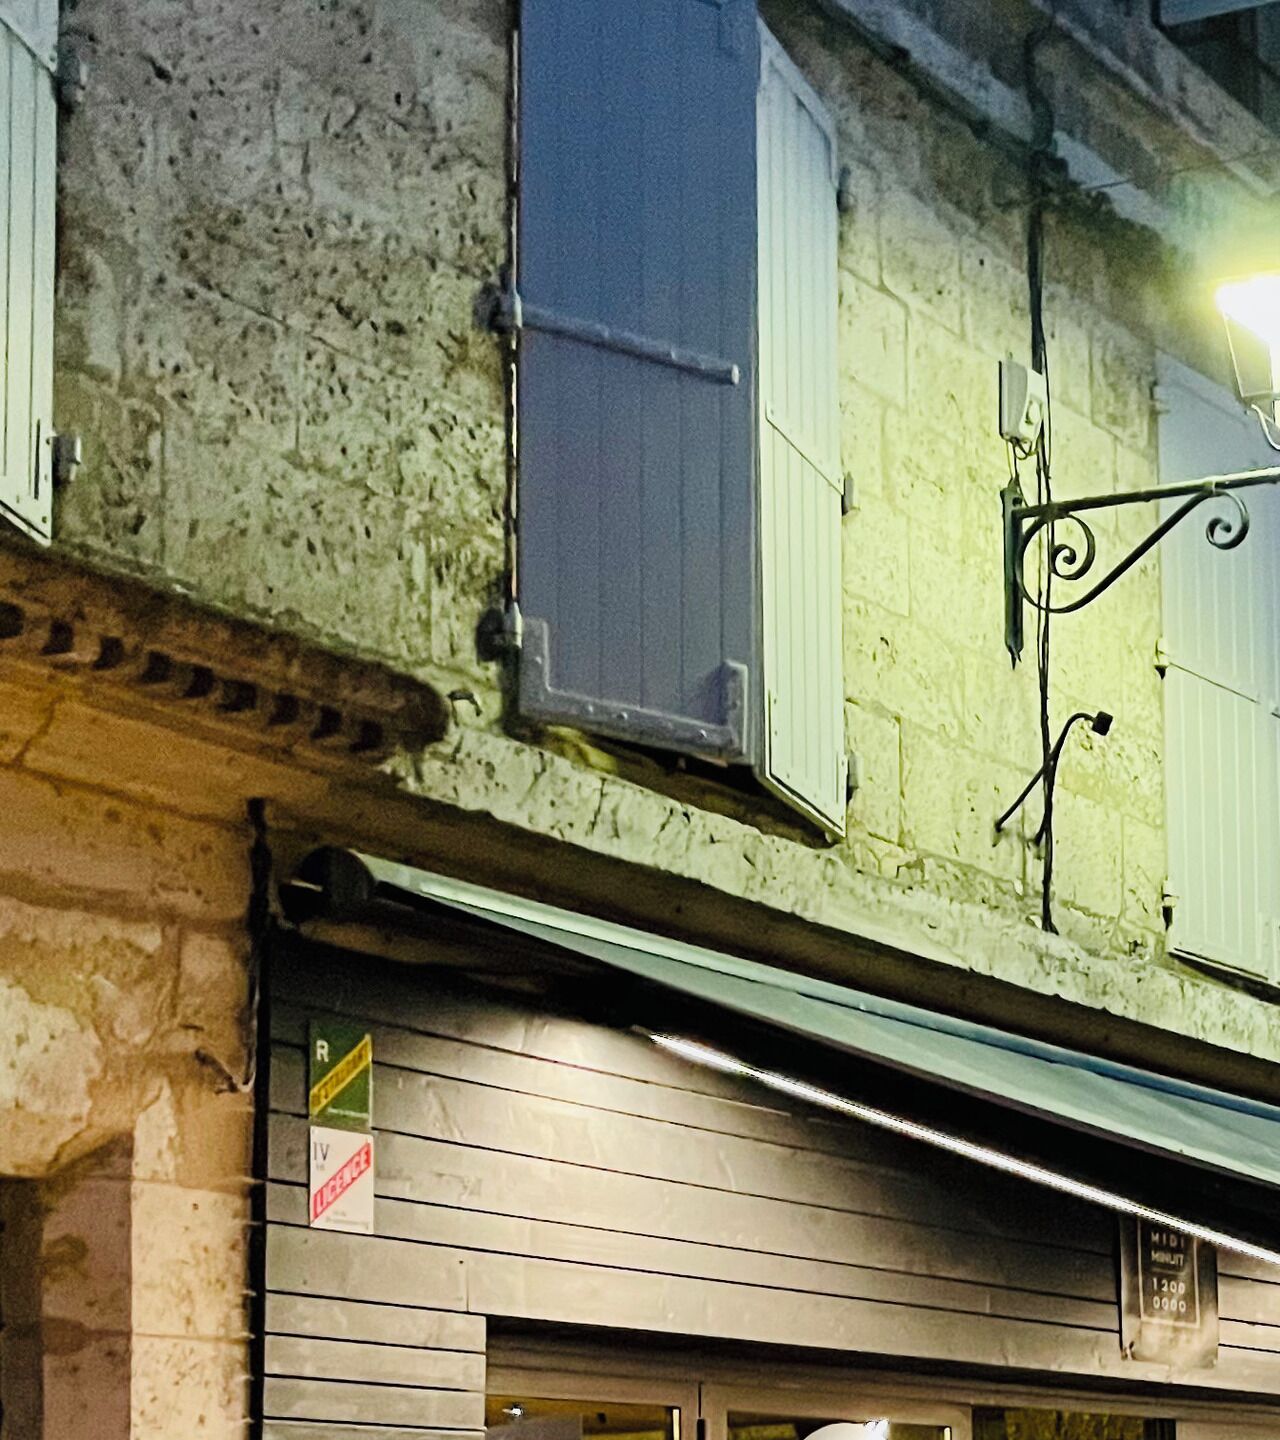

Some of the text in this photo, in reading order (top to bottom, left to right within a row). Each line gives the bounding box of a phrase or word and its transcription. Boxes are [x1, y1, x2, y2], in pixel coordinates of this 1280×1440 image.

[314, 1145, 370, 1216] LICENCE
[1151, 1231, 1185, 1248] MIDI
[1151, 1250, 1184, 1267] MINUIT
[1152, 1277, 1186, 1295] 1200
[1152, 1296, 1187, 1313] 0000
